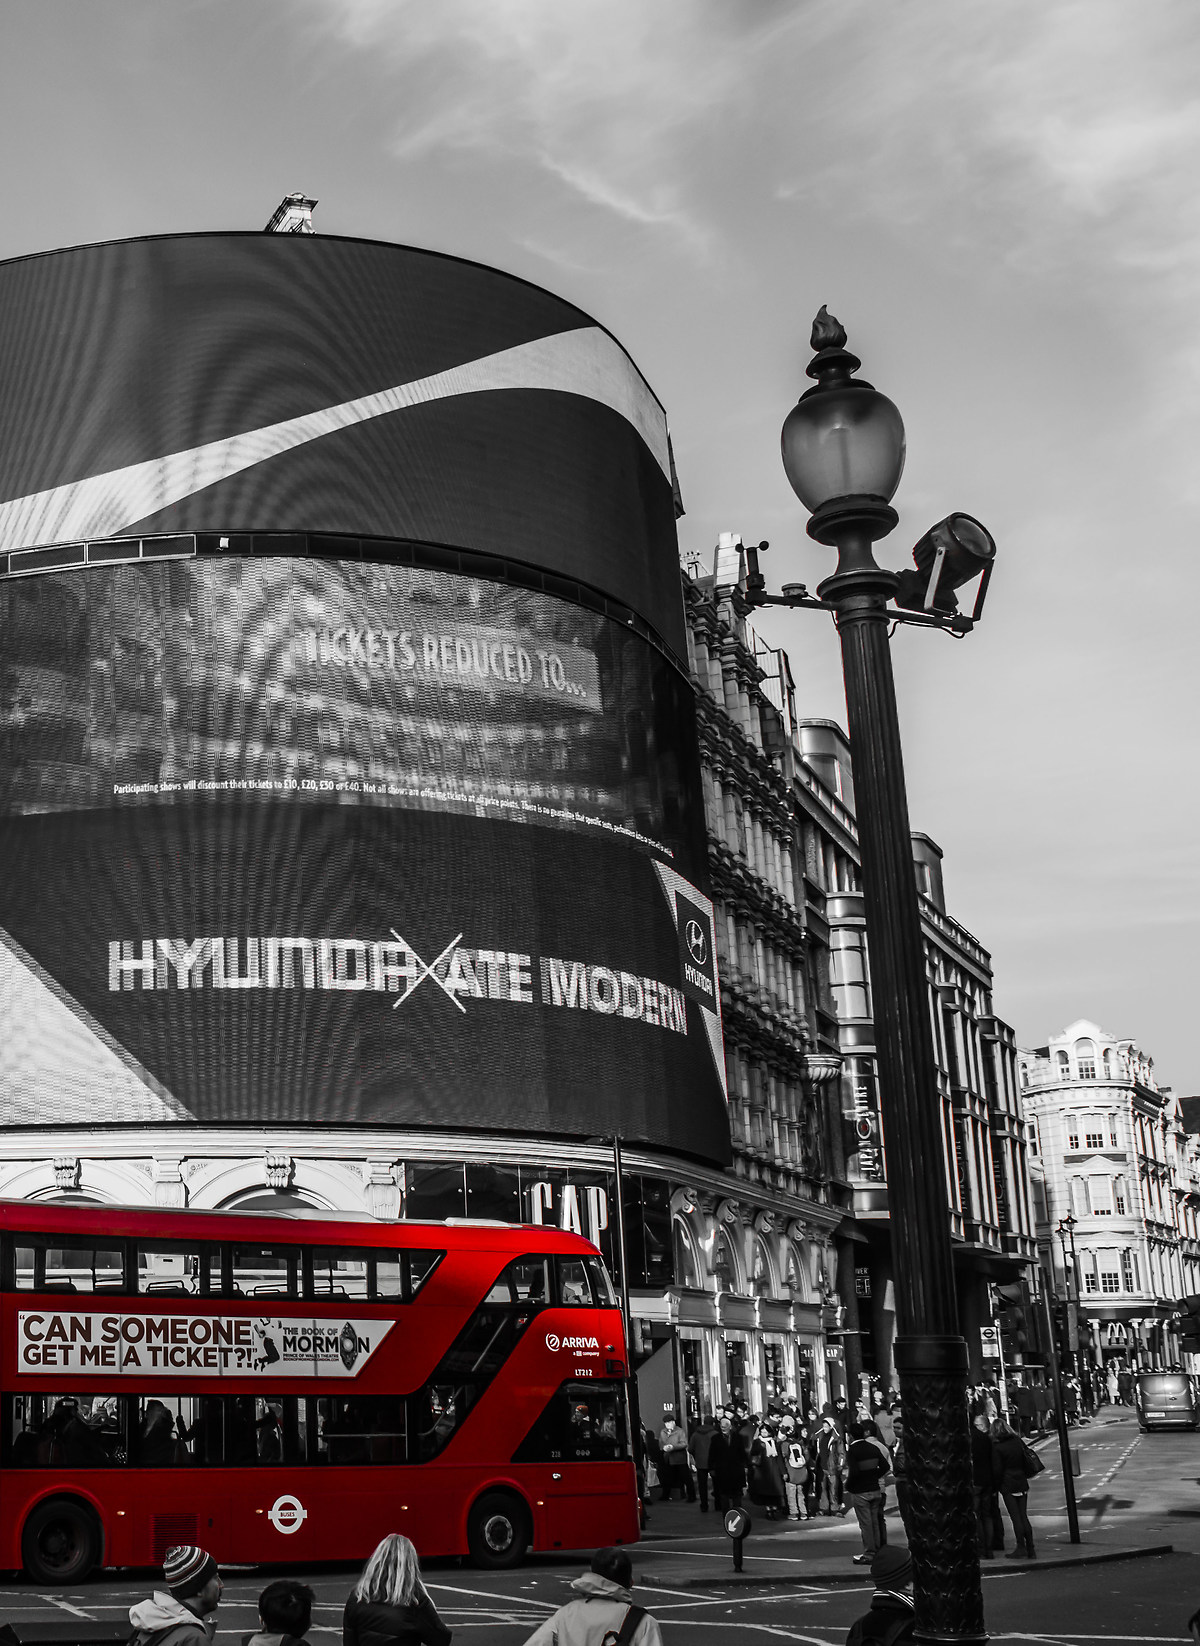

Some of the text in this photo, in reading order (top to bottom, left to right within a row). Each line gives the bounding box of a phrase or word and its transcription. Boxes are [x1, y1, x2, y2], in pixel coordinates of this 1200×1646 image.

[301, 627, 416, 670] TICKETS
[422, 634, 533, 684] REDUCED
[113, 782, 159, 794] Participating
[160, 781, 181, 791] shows
[183, 780, 196, 790] will
[197, 780, 228, 790] discount
[230, 780, 247, 789] their
[249, 780, 273, 789] tickets
[274, 781, 282, 789] to
[363, 784, 376, 793] Not
[378, 785, 387, 794] all
[540, 956, 688, 1035] MODERN
[100, 1317, 252, 1346] SOMEONE
[283, 1327, 298, 1335] THE
[301, 1327, 325, 1335] BOOK
[561, 1336, 600, 1348] ARRIVA
[23, 1343, 77, 1366] GET
[81, 1344, 116, 1366] ME
[122, 1346, 142, 1367] A
[826, 1349, 838, 1358] GAP
[574, 1369, 593, 1377] LT212
